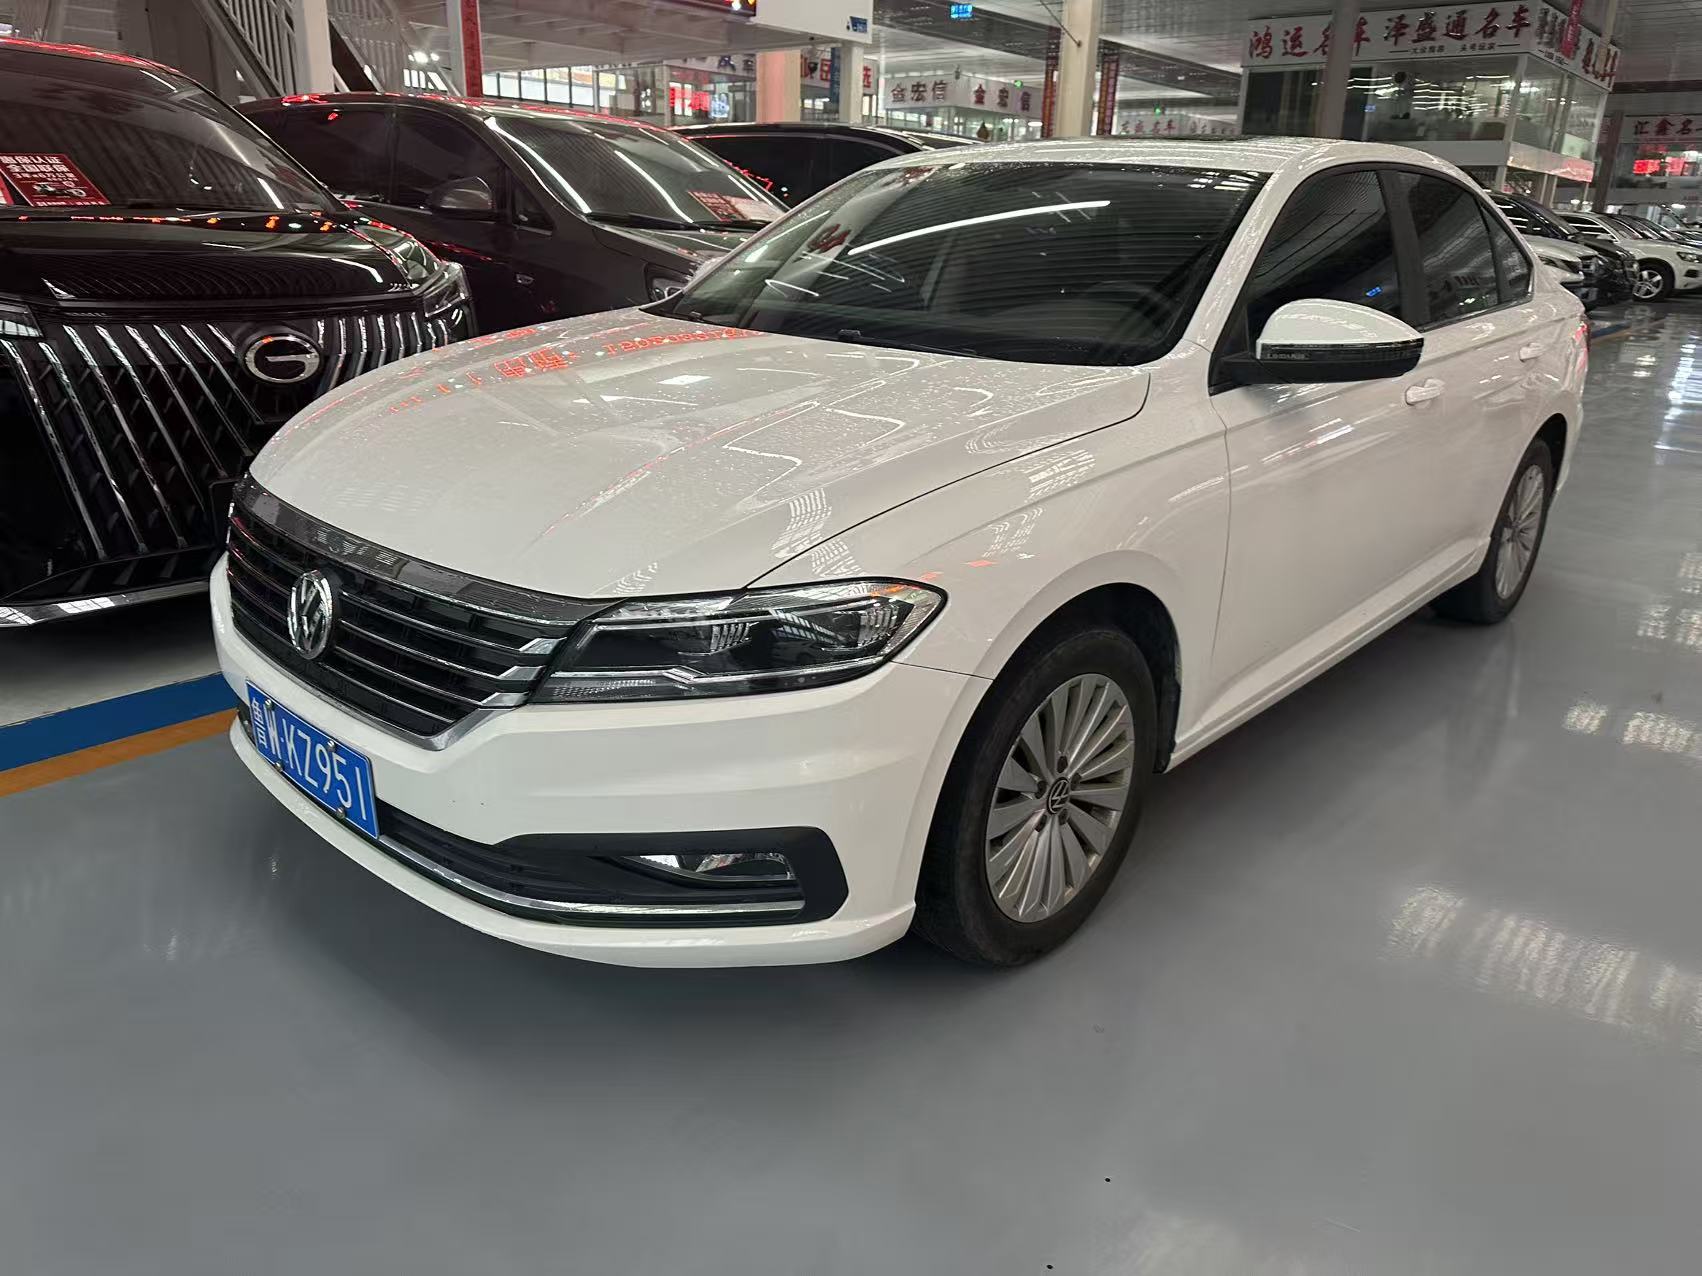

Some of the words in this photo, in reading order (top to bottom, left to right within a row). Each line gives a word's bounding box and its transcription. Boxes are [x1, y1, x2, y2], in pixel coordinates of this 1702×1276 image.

[1383, 4, 1531, 43] 泽盛通名车
[891, 80, 949, 103] 金宏信
[974, 83, 1032, 112] 金宏信
[1633, 117, 1702, 136] 汇鑫名
